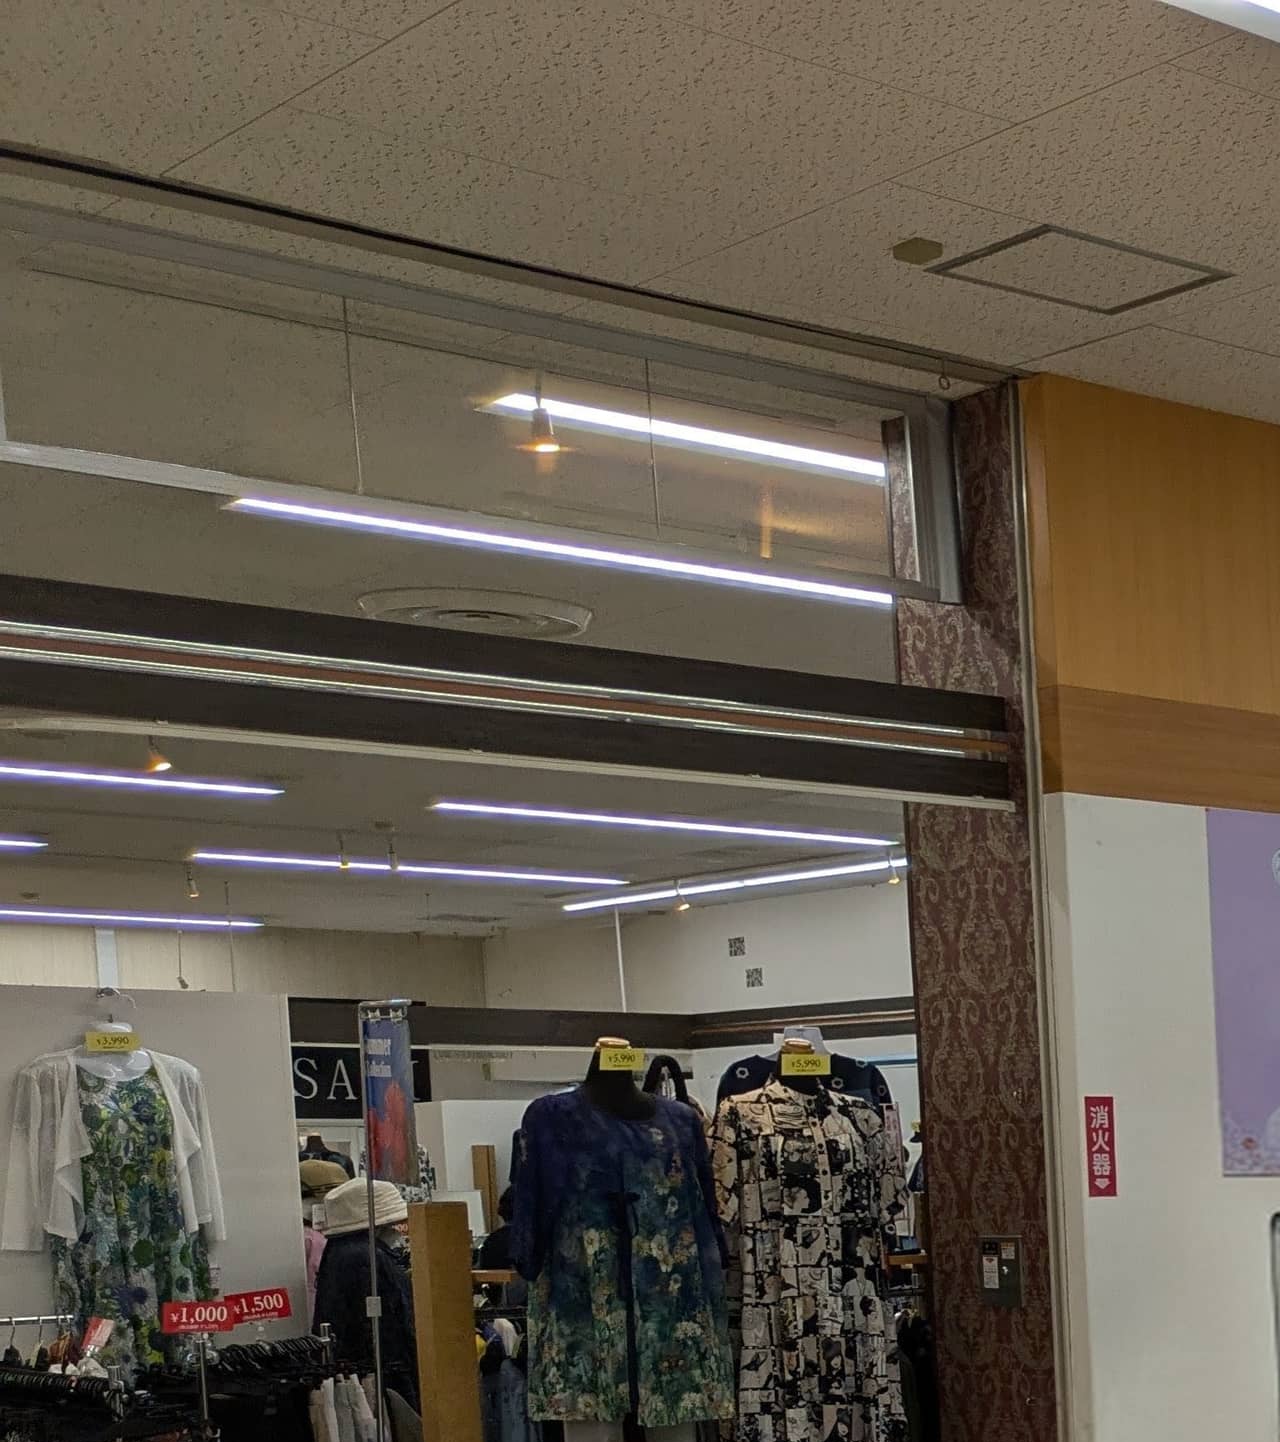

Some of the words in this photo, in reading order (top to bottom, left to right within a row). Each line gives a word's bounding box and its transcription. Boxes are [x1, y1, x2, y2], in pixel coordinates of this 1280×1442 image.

[1090, 1105, 1111, 1176] 消火器
[170, 1306, 228, 1323] ¥1,000
[233, 1293, 284, 1315] ¥1,500
